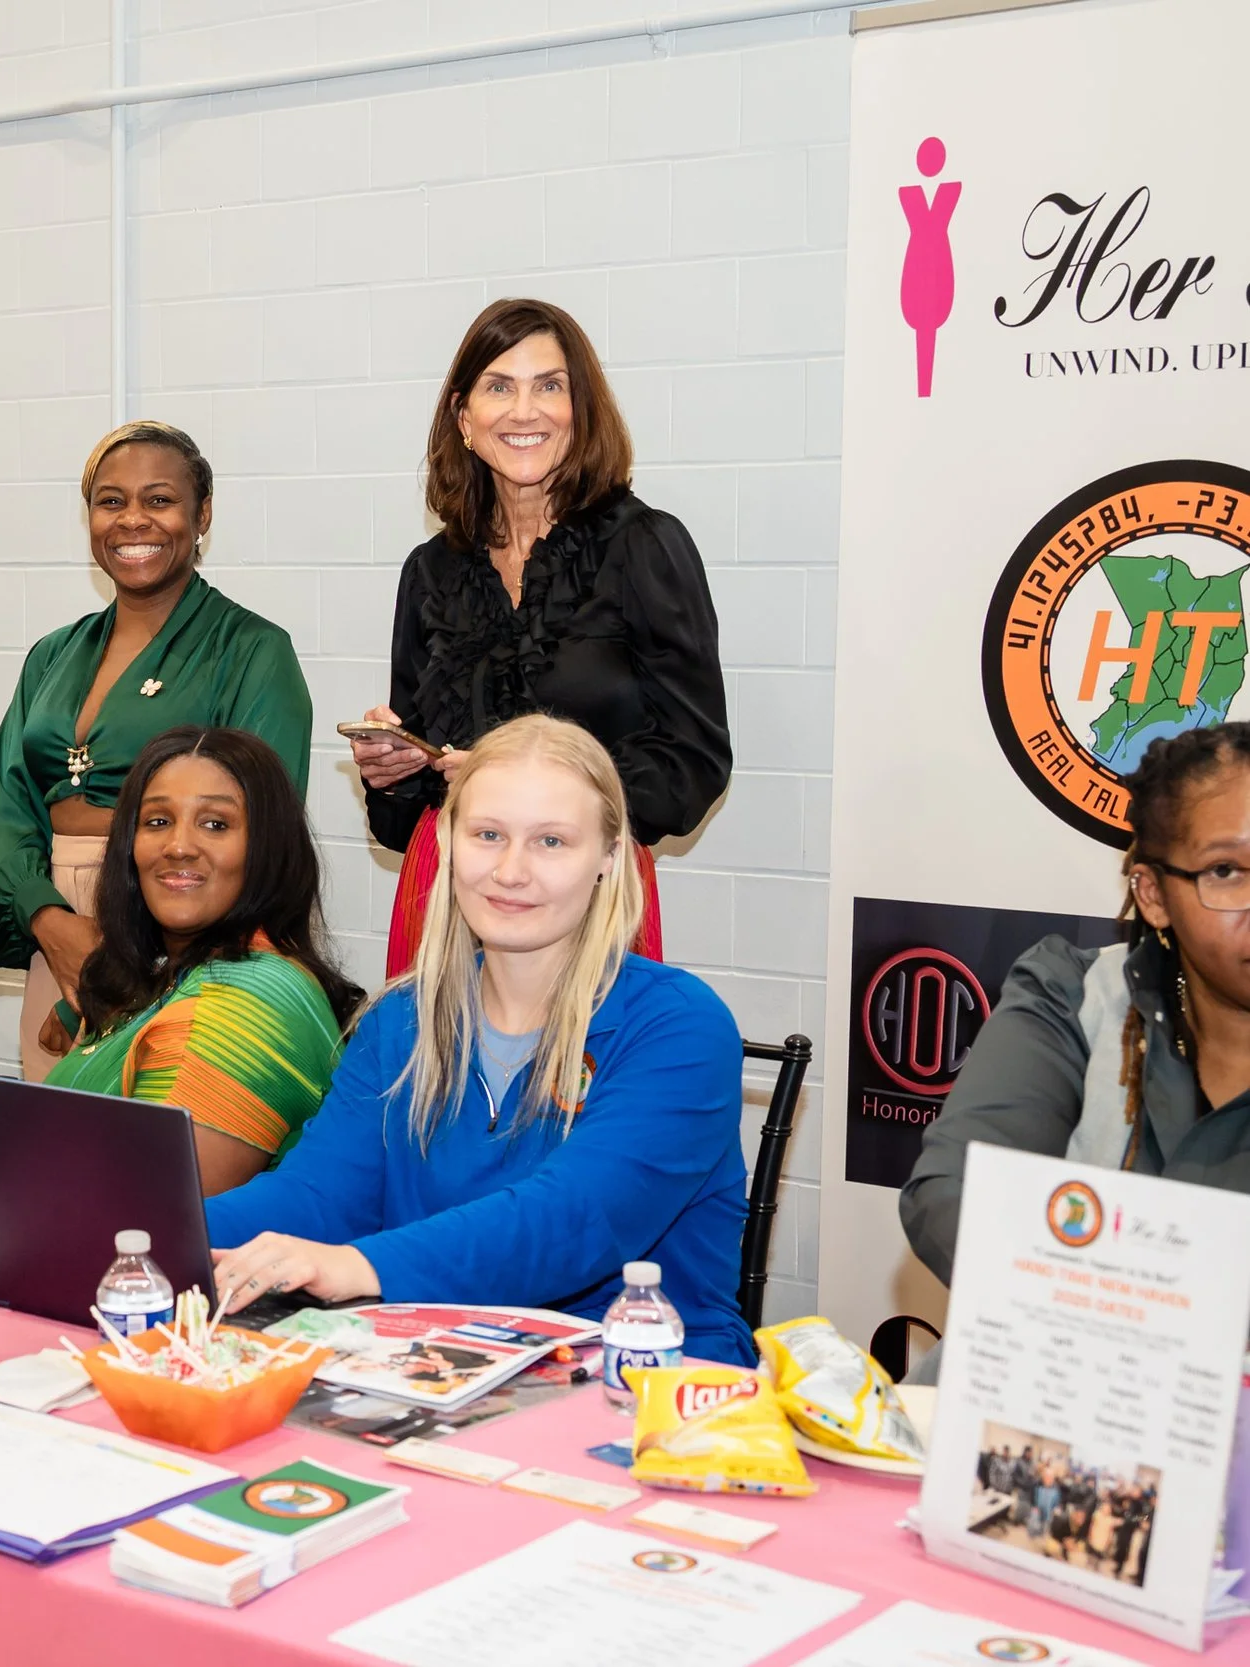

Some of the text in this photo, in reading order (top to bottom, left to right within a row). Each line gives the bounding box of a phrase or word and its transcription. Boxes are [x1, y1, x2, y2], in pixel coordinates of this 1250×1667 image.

[994, 186, 1215, 327] Her
[1024, 344, 1177, 379] UNWIND.
[1077, 610, 1242, 706] HT
[1027, 729, 1075, 788] REAL
